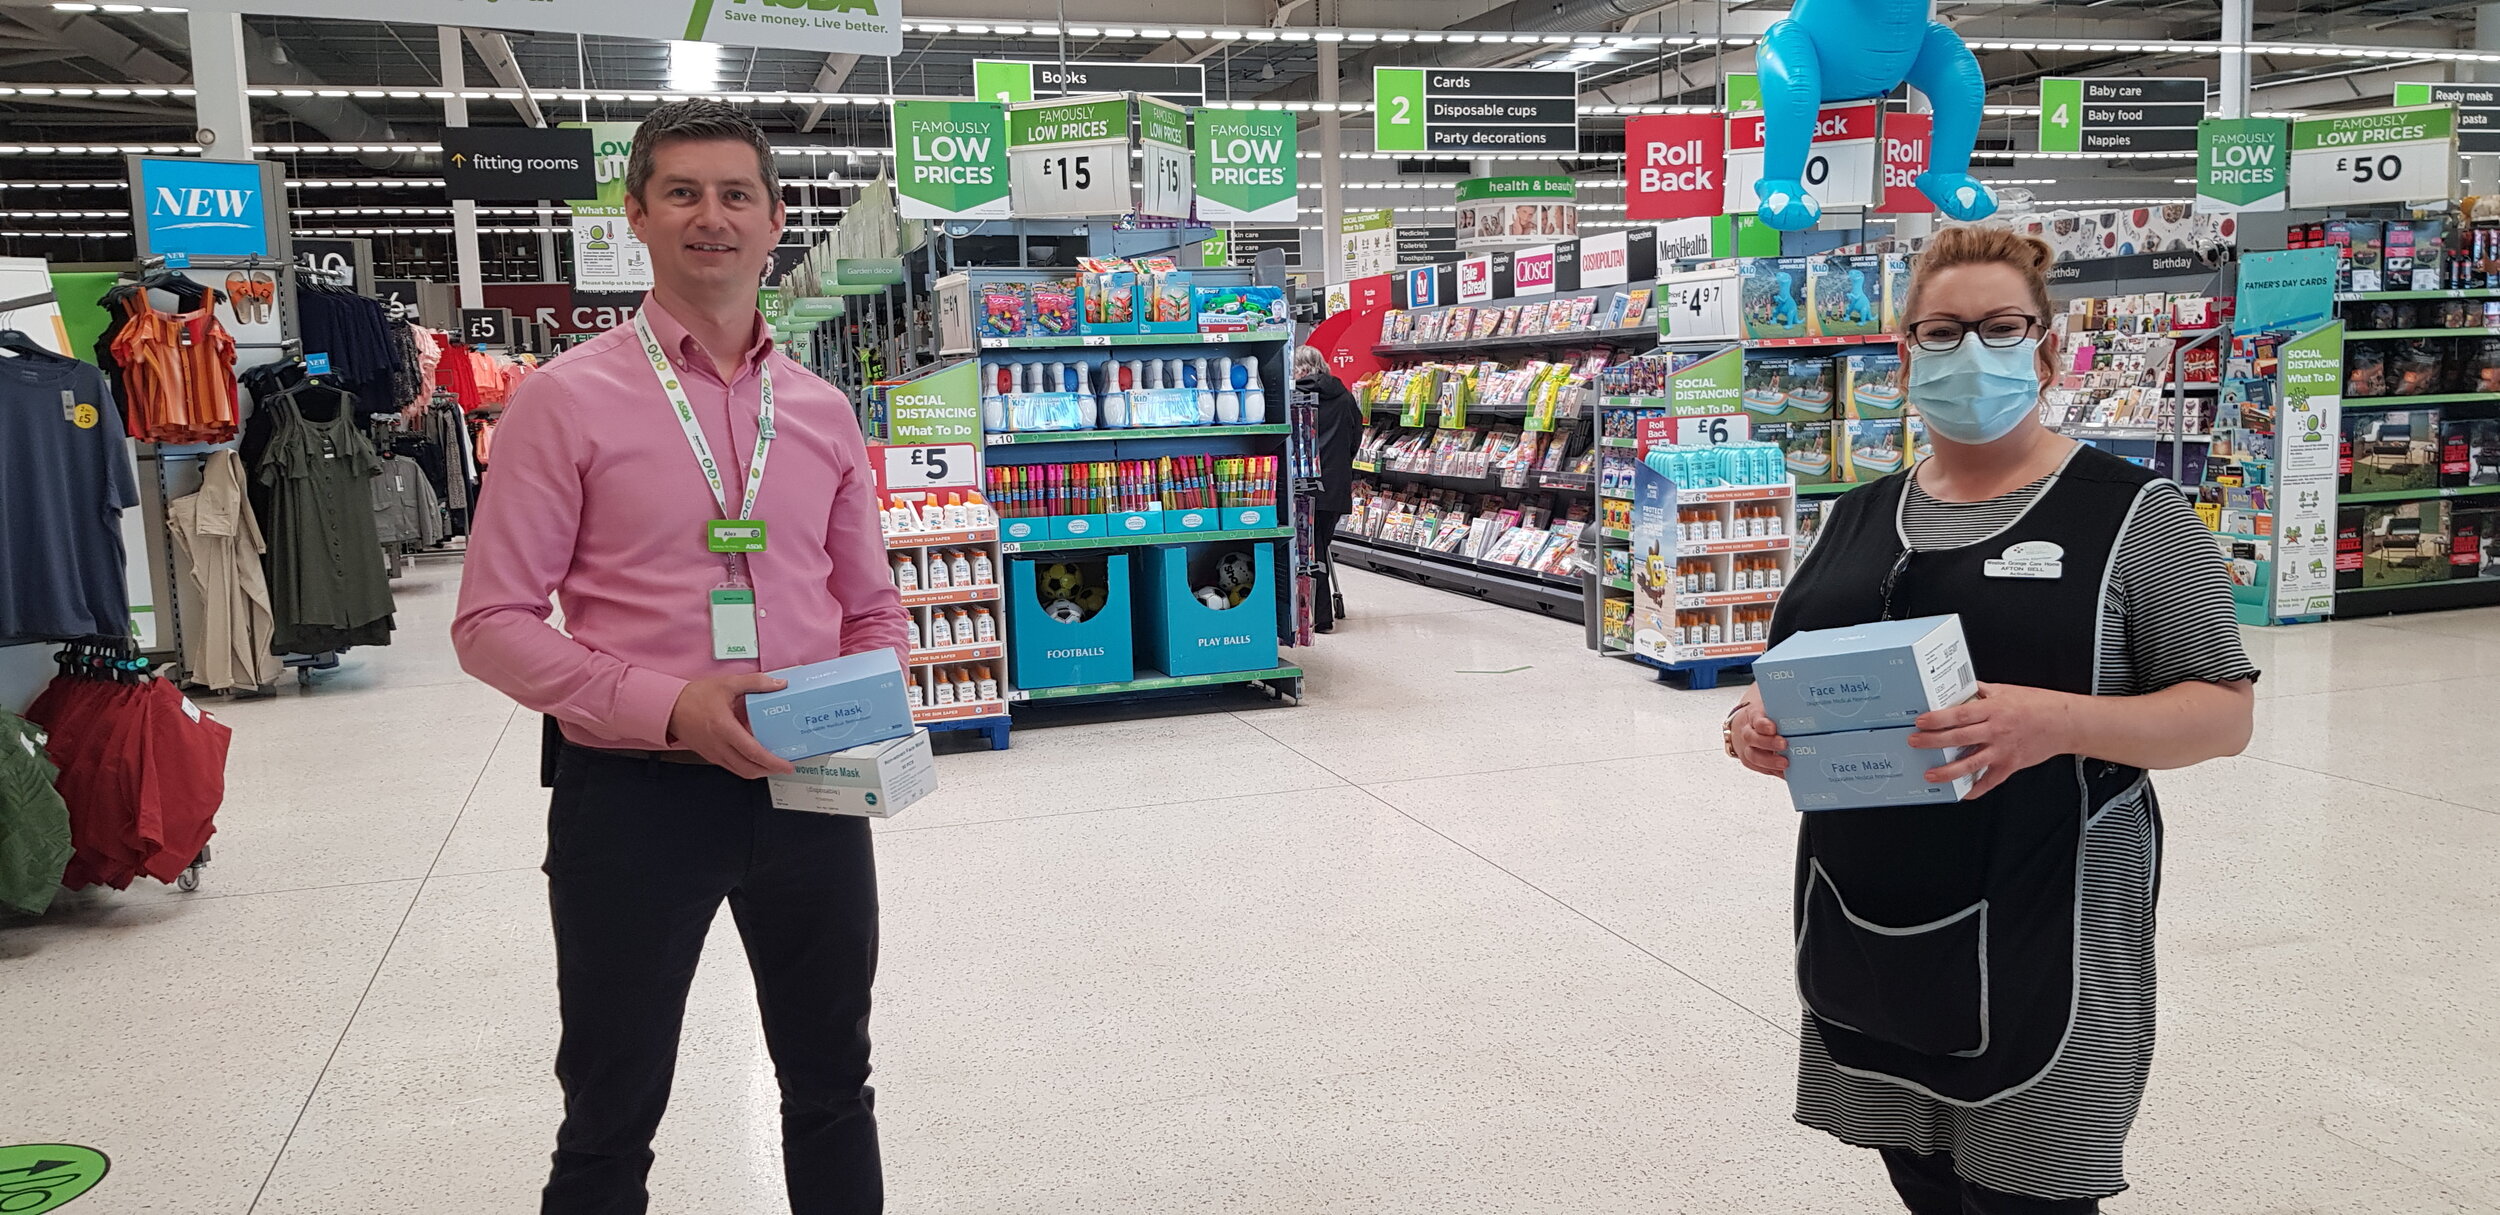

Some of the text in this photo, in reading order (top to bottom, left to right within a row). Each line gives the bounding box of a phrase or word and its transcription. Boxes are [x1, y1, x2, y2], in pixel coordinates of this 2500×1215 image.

[724, 10, 889, 34] Save money. Live better.
[1433, 76, 1471, 88] Cards
[2089, 86, 2142, 97] Baby care
[2435, 90, 2493, 102] Ready meals
[1039, 106, 1096, 123] FAMOUSLY
[1153, 107, 1177, 126] FAMOUSLY
[1390, 96, 1411, 124] 2
[1434, 104, 1537, 118] Disposable cups
[2051, 104, 2069, 128] 4
[2088, 110, 2143, 122] Baby food
[2333, 114, 2408, 131] FAMOUSLY
[2463, 115, 2488, 125] pasta
[912, 121, 991, 134] FAMOUSLY
[1028, 125, 1058, 142] LOW
[1149, 121, 1163, 139] LOW
[1210, 125, 1283, 136] FAMOUSLY
[1434, 132, 1547, 145] Party decorations
[2087, 136, 2131, 147] Nappies
[2211, 132, 2276, 145] FAMOUSLY
[2317, 131, 2357, 146] LOW
[912, 136, 991, 163] LOW
[1210, 139, 1283, 164] LOW
[1646, 139, 1702, 167] Roll
[1887, 139, 1923, 163] Roll
[2211, 144, 2275, 168] LOW
[473, 154, 579, 173] fitting rooms
[1640, 166, 1713, 193] Back
[1489, 180, 1573, 193] health & beauty
[152, 187, 254, 218] NEW
[577, 206, 618, 215] What To
[1628, 231, 1652, 242] Magazines
[1204, 242, 1225, 256] 27
[1583, 249, 1625, 272] COSMOPOLITAN
[2152, 256, 2192, 270] Birthday
[847, 266, 894, 275] Garden décor
[1462, 265, 1478, 281] Take
[1516, 260, 1551, 282] Closer
[1740, 266, 1755, 274] KID
[1812, 264, 1829, 272] KID
[1468, 279, 1487, 294] Break
[2244, 278, 2328, 290] FATHER'S DAY CARDS
[2287, 349, 2322, 359] SOCIAL
[2287, 359, 2340, 370] DISTANCING
[1675, 378, 1717, 389] SOCIAL
[2287, 373, 2336, 383] What To Do
[895, 395, 946, 406] SOCIAL
[1675, 389, 1739, 400] DISTANCING
[676, 399, 692, 423] ASDA
[896, 407, 977, 419] DISTANCING
[1676, 404, 1735, 415] What To Do
[897, 424, 972, 436] What To Do
[1648, 421, 1664, 429] Roll
[1647, 430, 1667, 438] Back
[911, 448, 949, 480] £5
[2310, 601, 2330, 609] ASDA
[1197, 634, 1251, 647] PLAY BALLS
[1047, 647, 1105, 659] FOOTBALLS
[1809, 681, 1871, 697] Face Mask
[805, 706, 863, 725] Face Mask
[819, 766, 839, 776] Face
[839, 767, 861, 778] Mask
[1831, 759, 1893, 773] Face Mask
